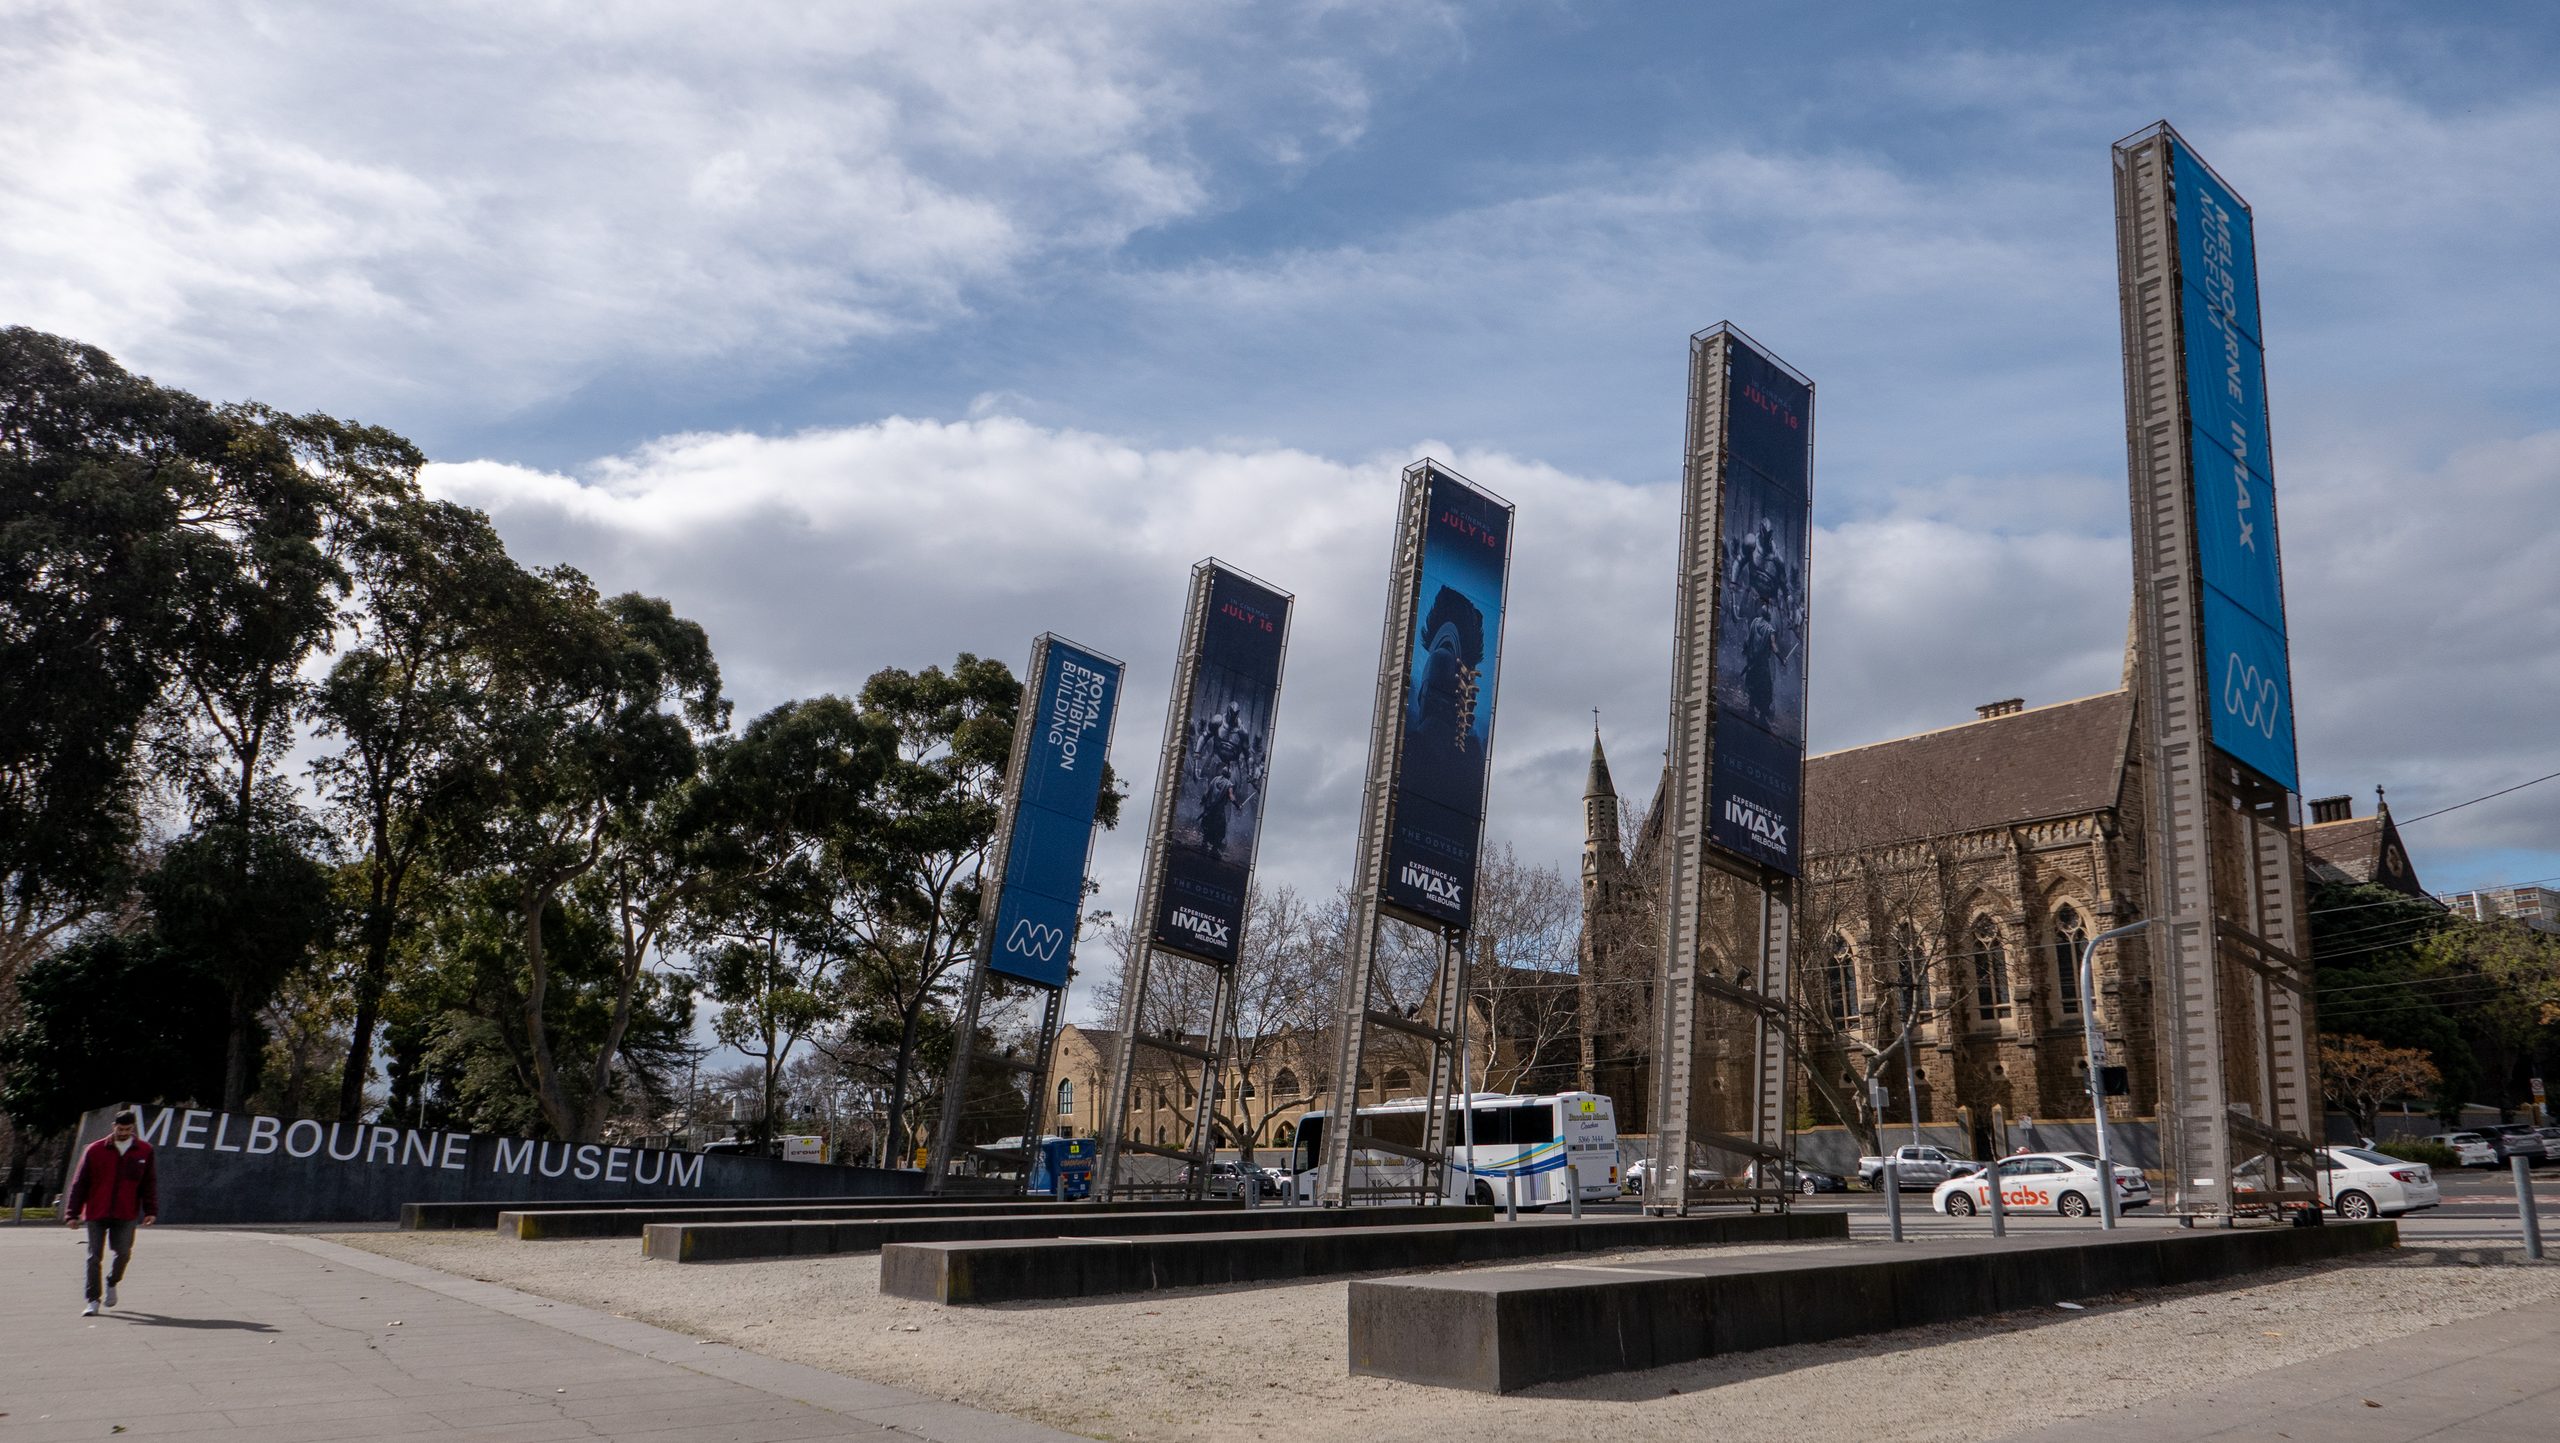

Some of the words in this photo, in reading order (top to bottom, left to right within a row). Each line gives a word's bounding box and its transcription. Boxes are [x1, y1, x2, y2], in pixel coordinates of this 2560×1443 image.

[2199, 188, 2222, 330] MUSEUM
[2215, 204, 2243, 405] MELBOURNE
[2230, 421, 2256, 558] IMAX
[1744, 384, 1778, 415] JULY
[1441, 511, 1476, 537] JULY
[1481, 532, 1496, 548] 16
[1221, 603, 1255, 624] JULY
[1259, 618, 1273, 632] 16
[1048, 660, 1077, 746] BUILDING
[1083, 673, 1105, 730] ROYAL
[1060, 666, 1091, 771] EXHIBITION
[1725, 799, 1787, 846] IMAX
[1732, 794, 1772, 818] EXPERIENCE
[1773, 813, 1783, 822] AT
[1401, 827, 1421, 841] THE
[1425, 836, 1471, 860] ODYSSEY
[1751, 832, 1788, 855] MELBOURNE
[1401, 866, 1462, 903] IMAX
[1409, 861, 1448, 880] EXPERIENCE
[1449, 875, 1458, 883] AT
[1195, 885, 1239, 904] ODYSSEY
[1426, 892, 1461, 911] MELBOURNE
[1171, 911, 1229, 941] IMAX
[1179, 906, 1216, 922] EXPERIENCE
[1195, 933, 1229, 949] MELBOURNE
[130, 1105, 471, 1170] MELBOURNE
[493, 1138, 704, 1188] MUSEUM
